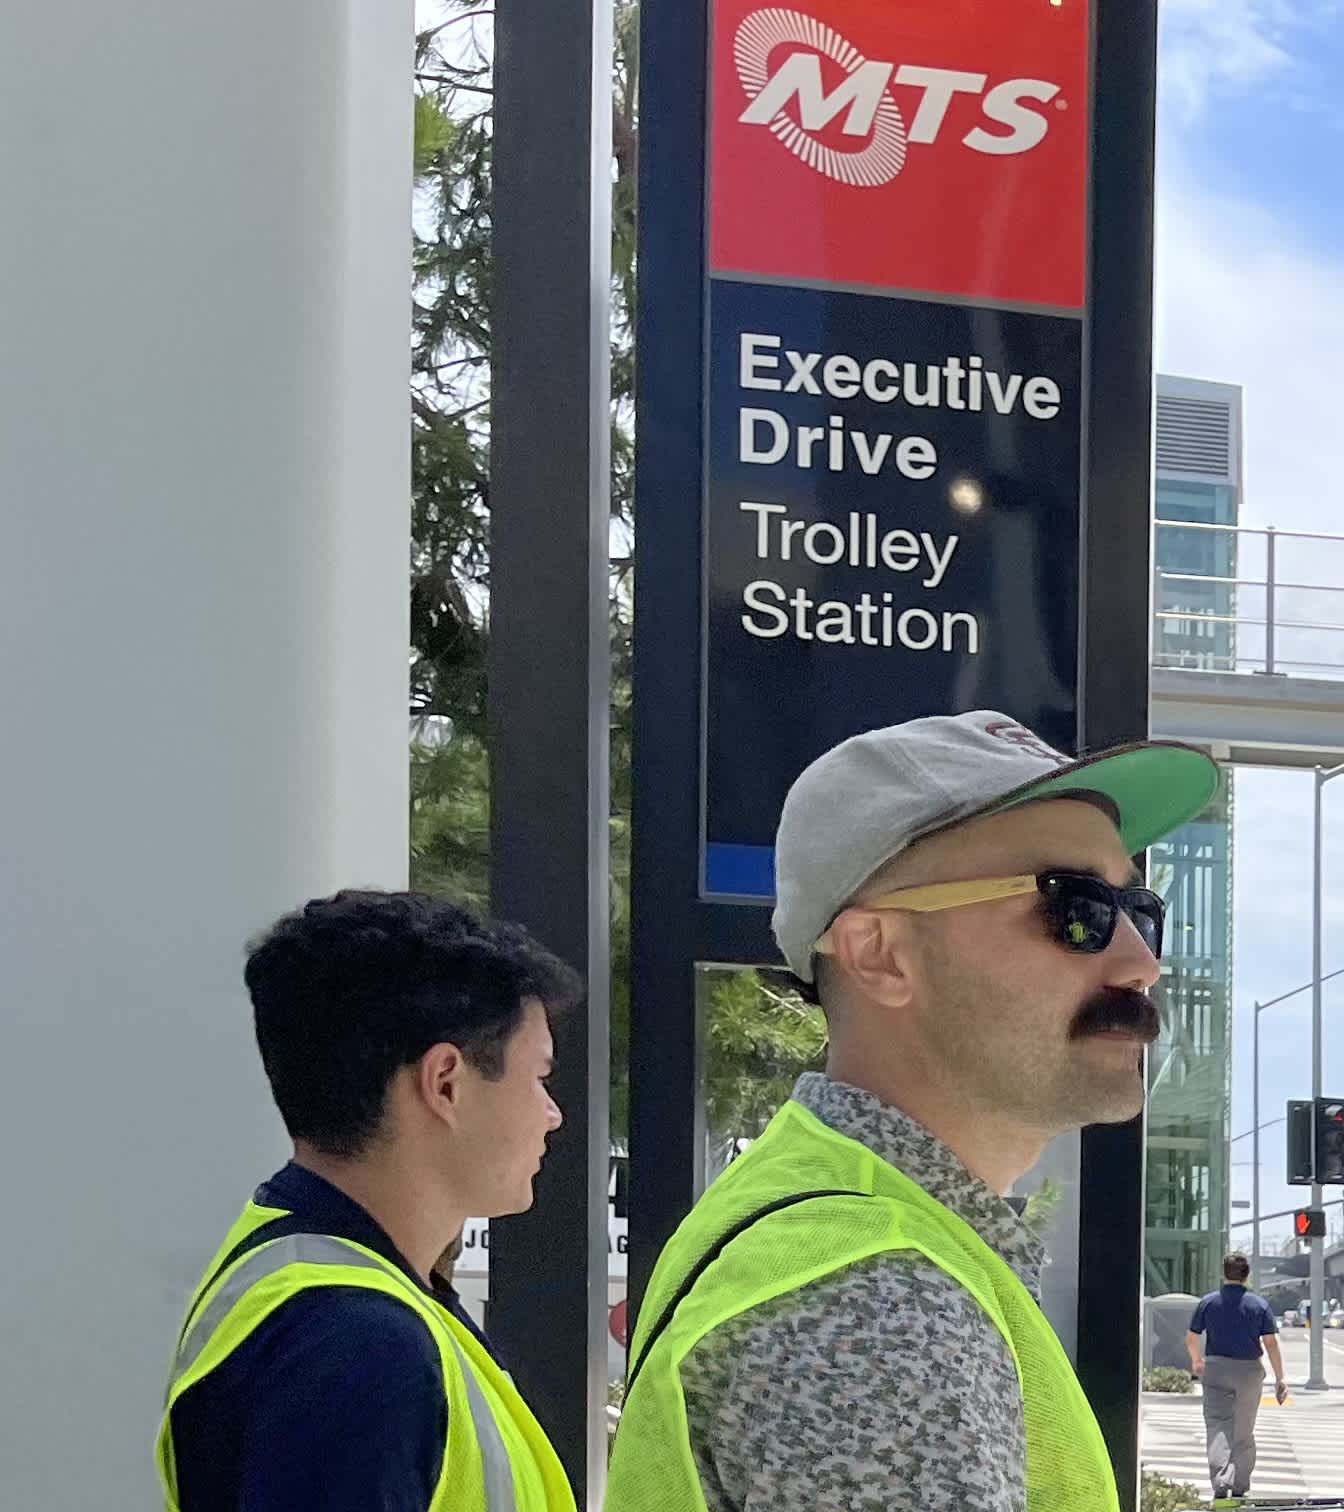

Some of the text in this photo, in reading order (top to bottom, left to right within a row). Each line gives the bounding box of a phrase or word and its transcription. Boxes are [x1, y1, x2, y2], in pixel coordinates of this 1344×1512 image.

[738, 53, 1060, 155] MTS
[738, 333, 1062, 421] Executive
[738, 407, 939, 480] Drive
[739, 501, 959, 589] Trolley
[740, 581, 980, 655] Station
